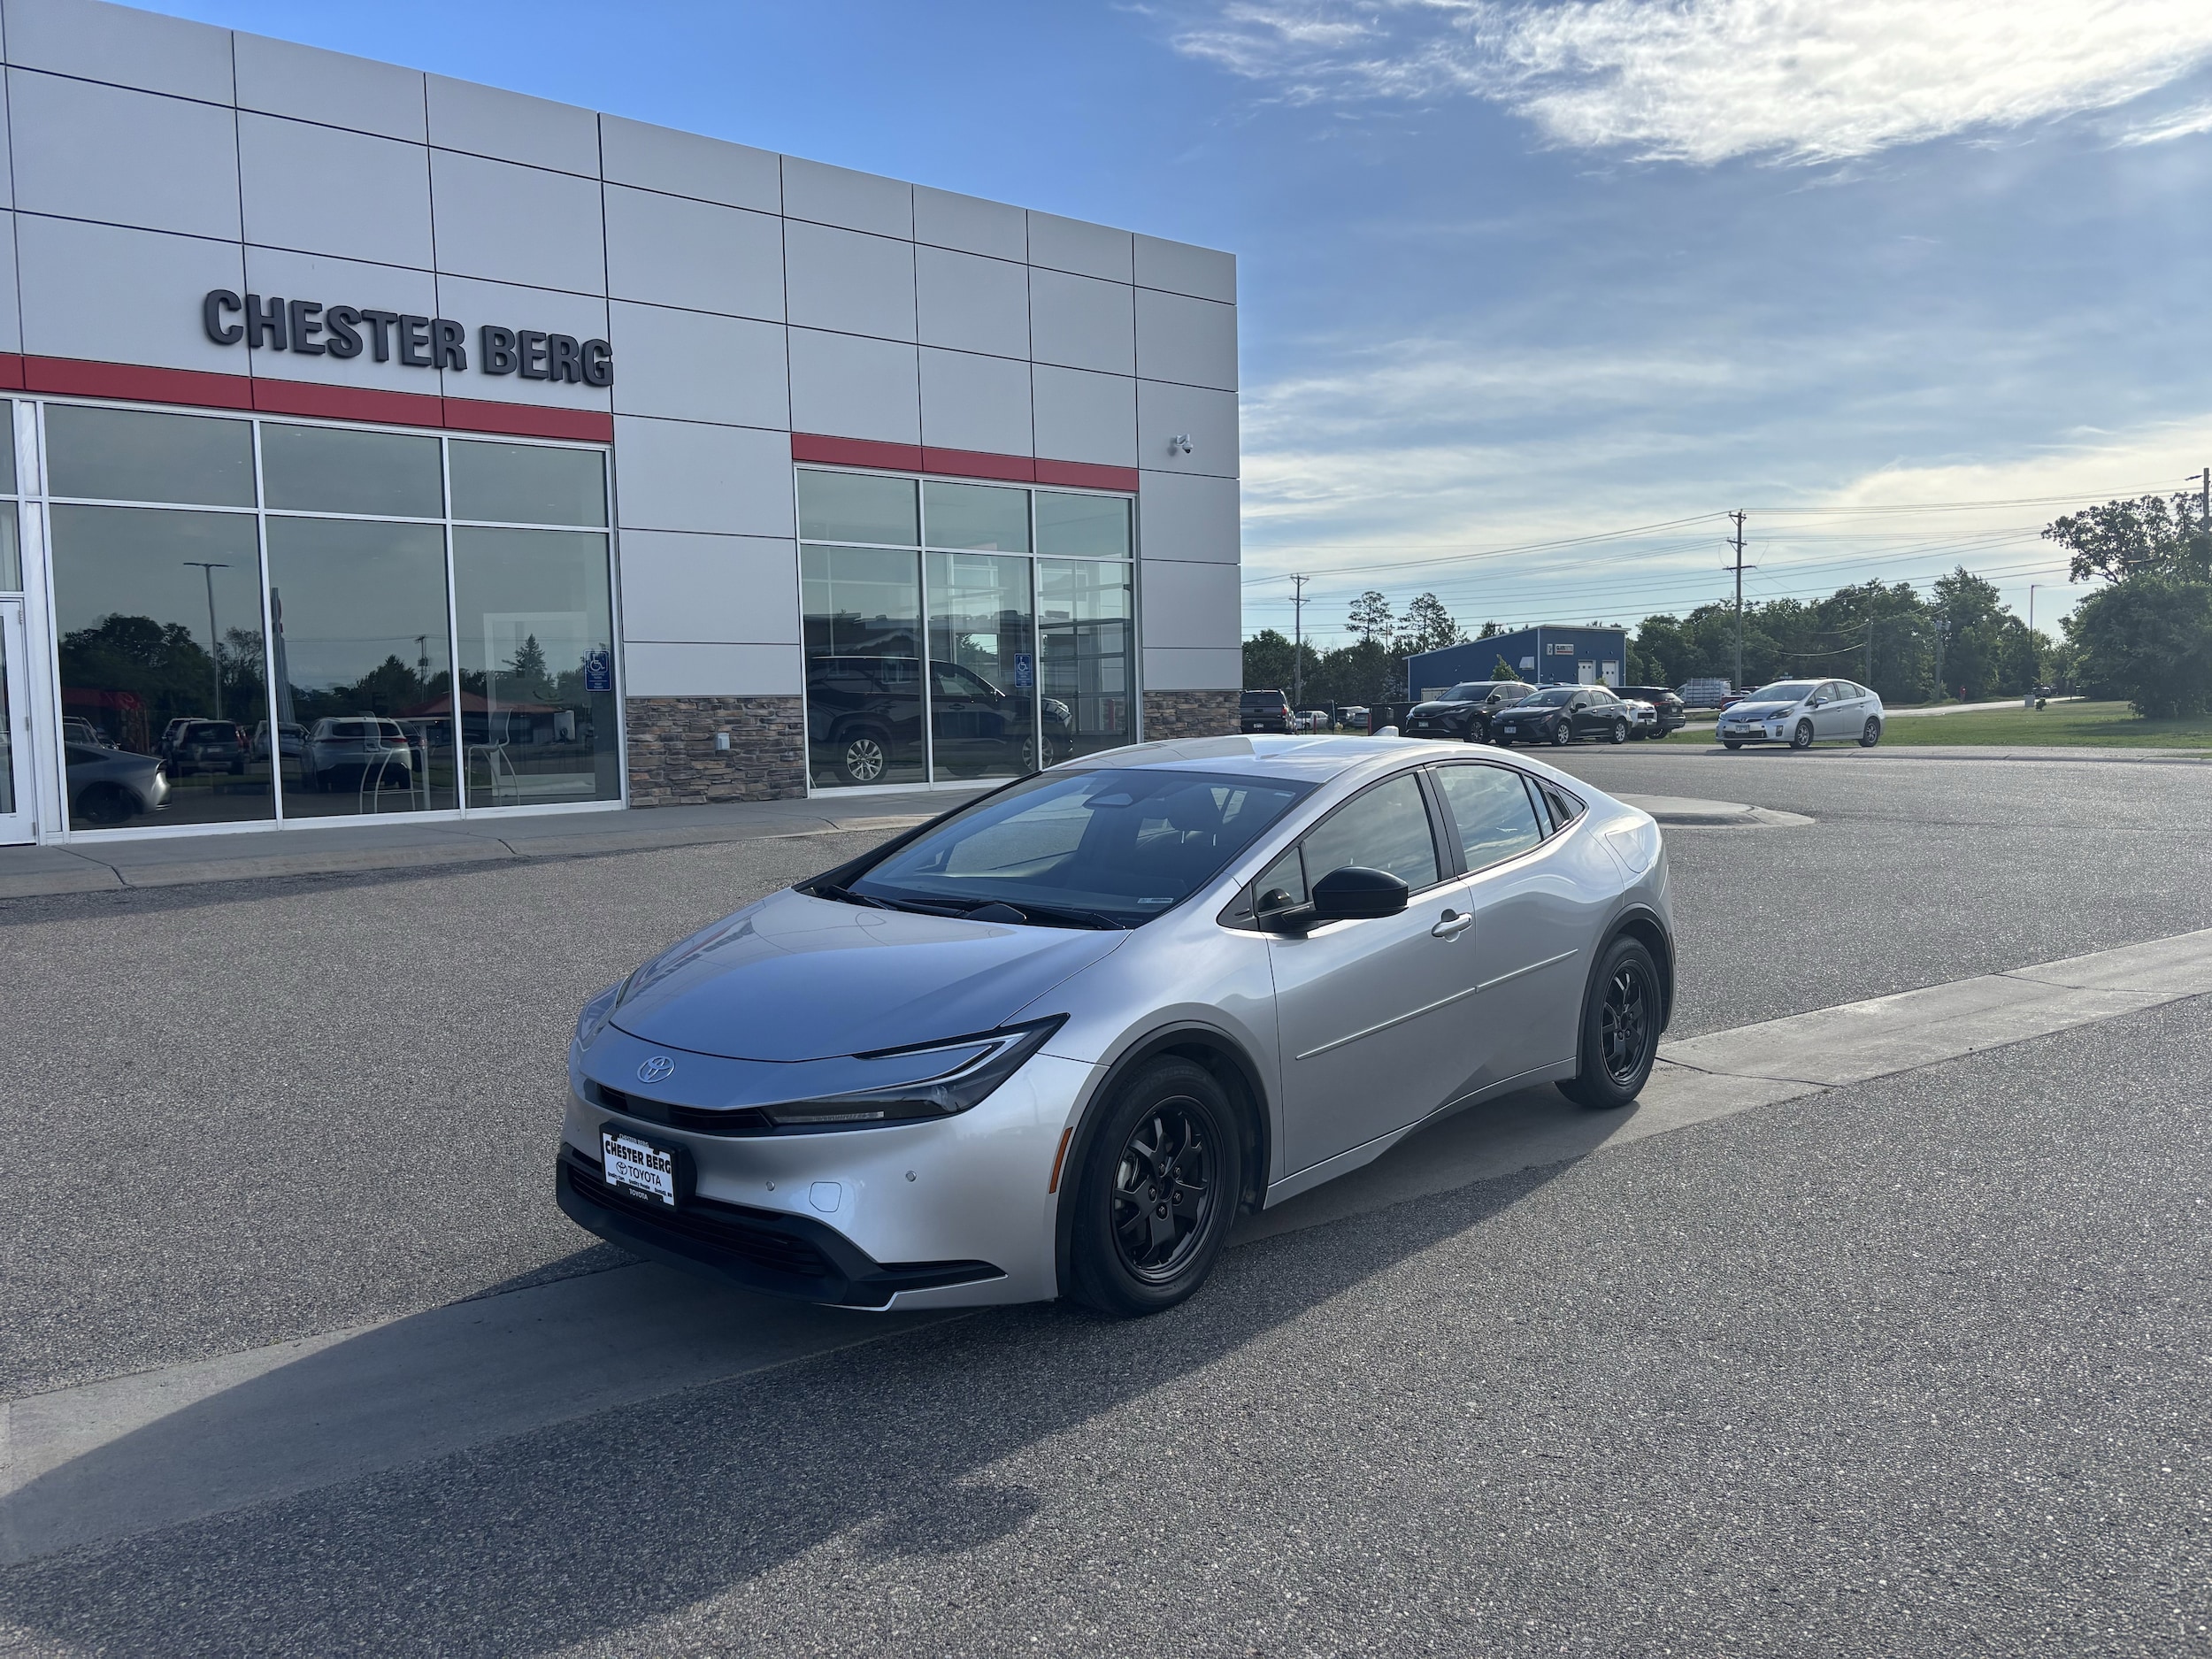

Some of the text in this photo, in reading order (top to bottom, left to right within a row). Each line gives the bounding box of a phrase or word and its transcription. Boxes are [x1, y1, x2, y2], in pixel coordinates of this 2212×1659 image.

[204, 289, 613, 387] CHESTER BERG
[619, 1133, 649, 1148] CHESTER BERG
[605, 1141, 672, 1174] CHESTER BERG
[627, 1165, 662, 1187] TOYOTA
[629, 1187, 649, 1201] TOYOTA
